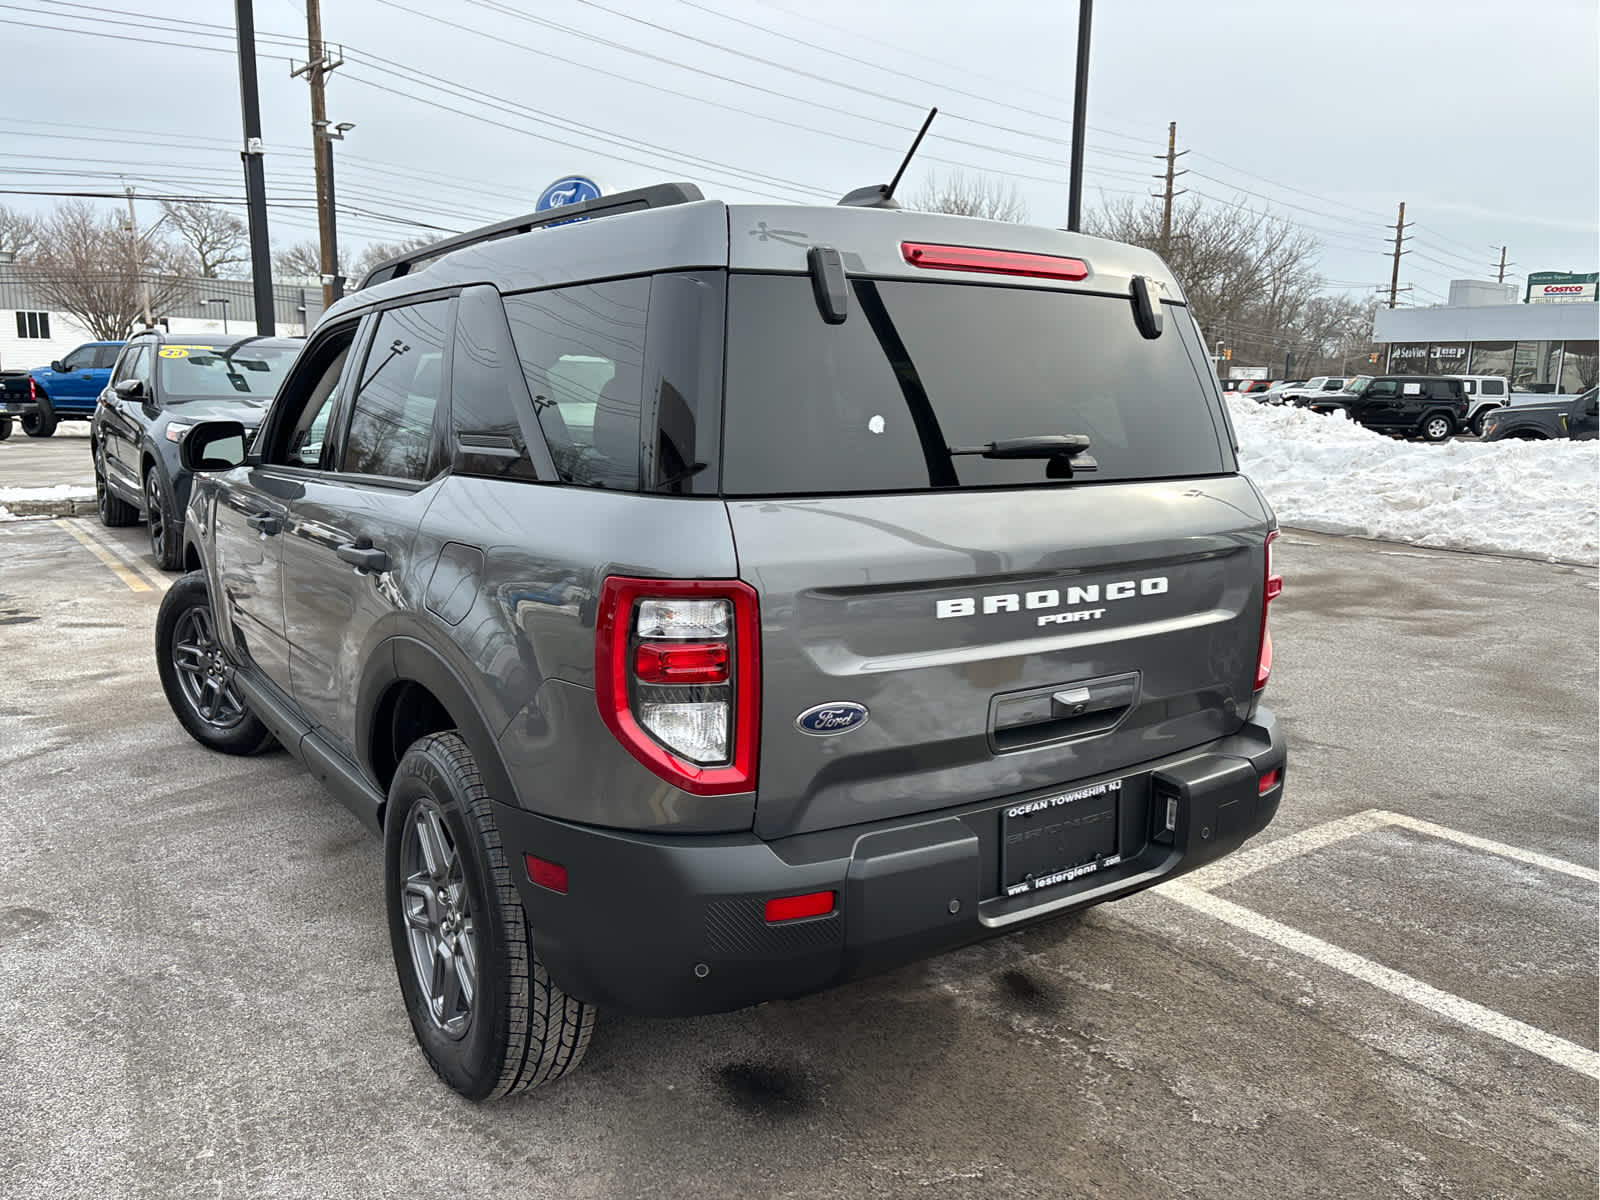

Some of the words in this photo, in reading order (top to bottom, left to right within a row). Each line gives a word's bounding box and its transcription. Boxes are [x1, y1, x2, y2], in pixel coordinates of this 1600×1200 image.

[1430, 346, 1466, 359] Jeep
[936, 576, 1168, 619] BRONCO
[1037, 608, 1106, 626] PORT
[814, 708, 855, 729] Ford
[1008, 800, 1048, 817] OCEAN
[1109, 780, 1122, 792] NJ
[1035, 863, 1097, 888] lesterglenn
